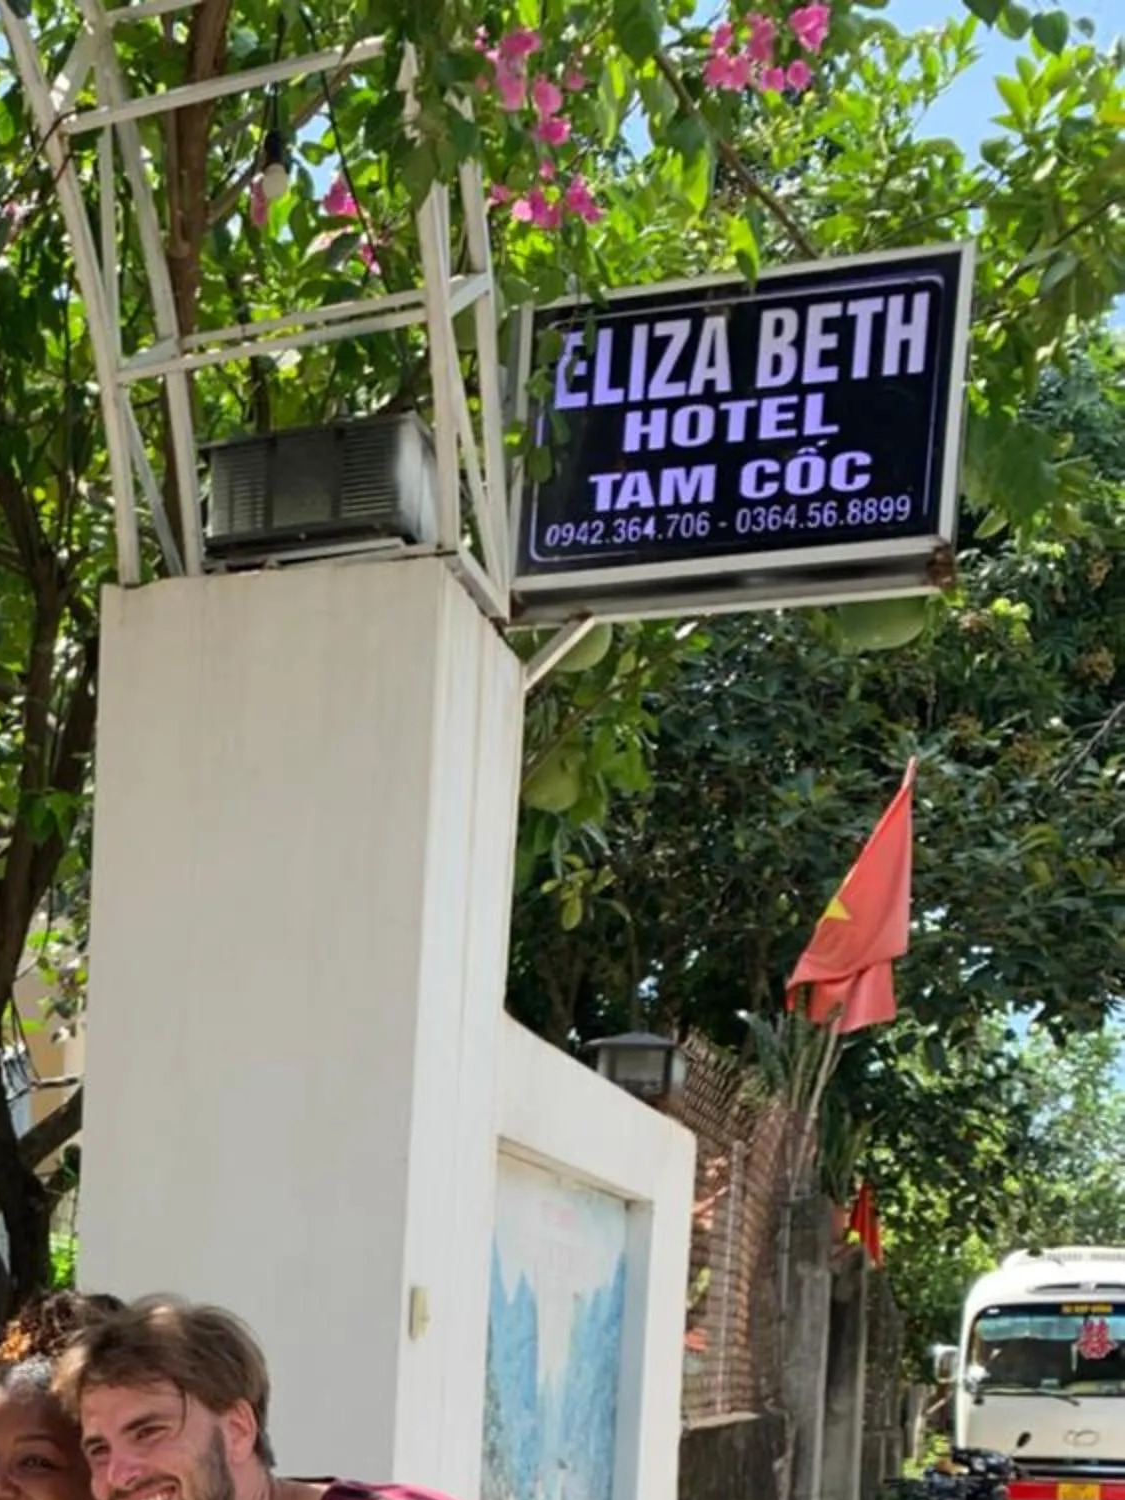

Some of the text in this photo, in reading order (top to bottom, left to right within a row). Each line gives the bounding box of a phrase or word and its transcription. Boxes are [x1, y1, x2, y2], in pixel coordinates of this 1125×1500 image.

[554, 292, 930, 409] ELIZA BETH
[623, 393, 839, 452] HOTEL
[589, 440, 872, 511] TAM CỐC
[545, 513, 710, 547] 0942.364.706
[736, 496, 910, 533] 0364.56.8899
